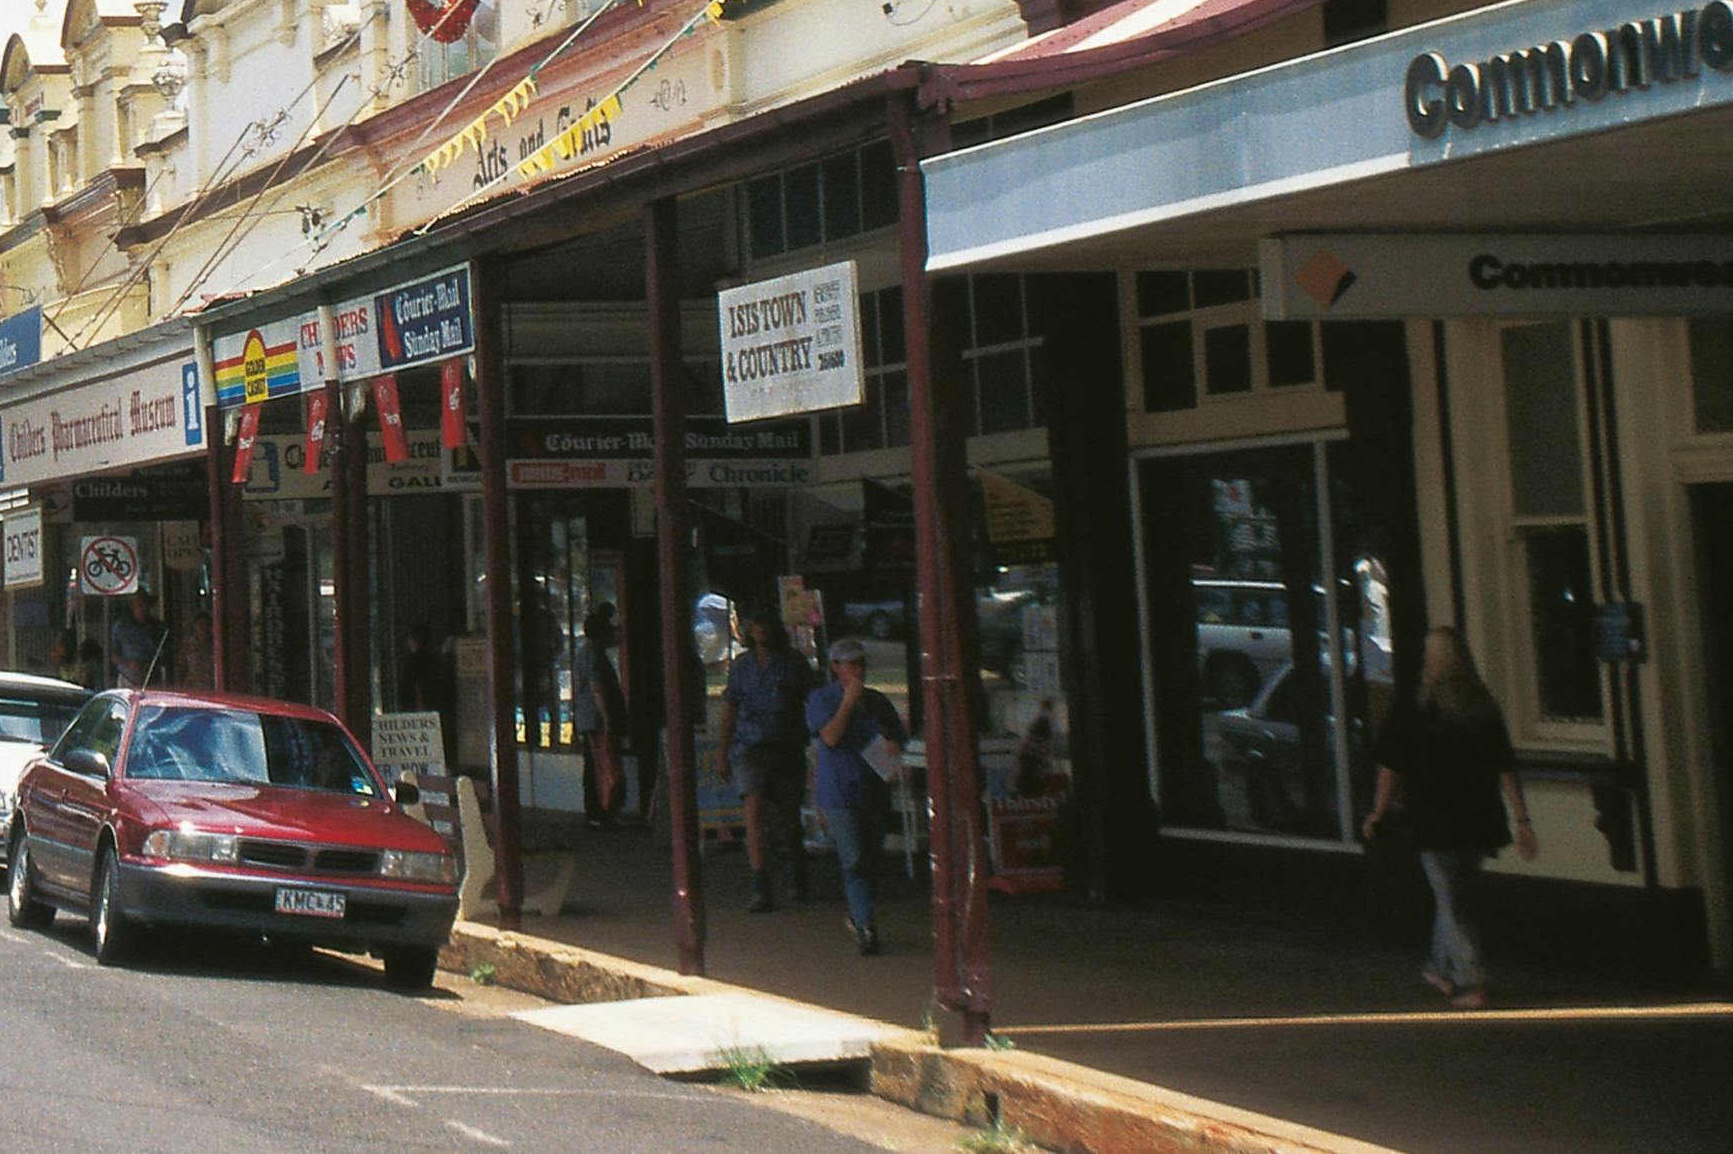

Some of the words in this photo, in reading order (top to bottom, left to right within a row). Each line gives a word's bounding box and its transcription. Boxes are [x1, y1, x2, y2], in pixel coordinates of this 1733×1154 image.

[395, 277, 460, 326] Courier-Mail
[728, 300, 759, 339] ISIS
[759, 290, 807, 332] TOWN
[301, 307, 369, 350] CHDERS
[403, 323, 440, 359] Sunday
[441, 316, 464, 348] Mail
[245, 357, 266, 377] GOLDEN
[726, 350, 738, 383] &
[739, 336, 813, 383] COUNTRY
[247, 377, 267, 398] CASKET
[130, 389, 177, 437] Museum
[545, 432, 655, 452] Courier-Ma
[685, 432, 753, 451] Sunday
[757, 431, 799, 448] Mail
[709, 464, 810, 483] Chronicle
[75, 482, 149, 498] Childers
[378, 718, 437, 731] HILDERS
[378, 732, 417, 744] NEWS
